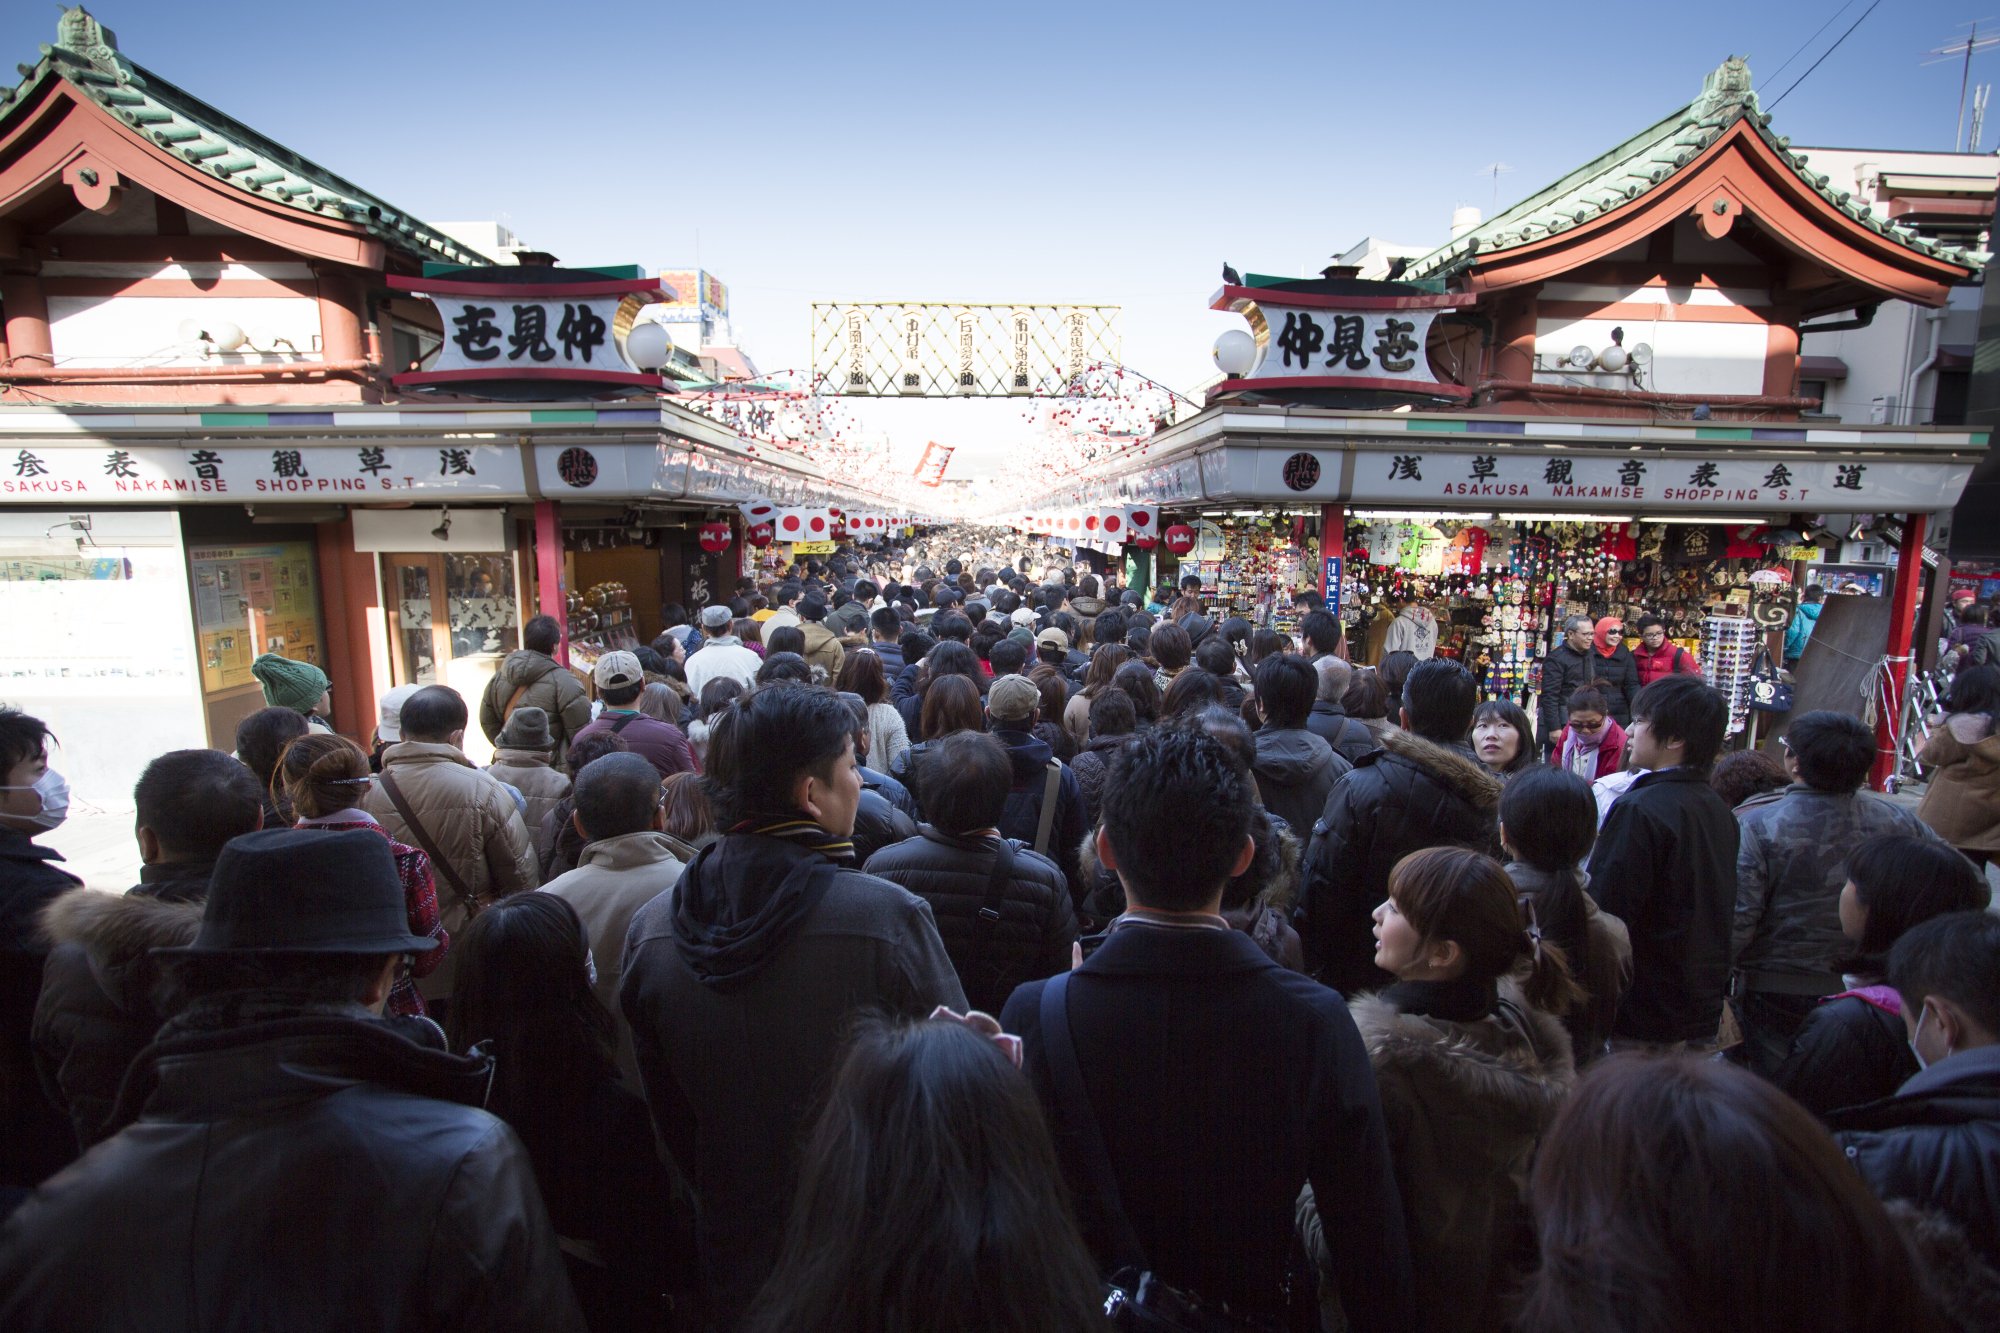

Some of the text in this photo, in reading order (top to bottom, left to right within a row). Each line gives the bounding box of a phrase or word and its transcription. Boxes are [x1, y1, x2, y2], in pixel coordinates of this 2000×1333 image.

[1277, 312, 1419, 372] 仲見世
[0, 480, 88, 492] SAKUSA
[115, 478, 227, 492] NAKAMISE
[255, 478, 365, 491] SHOPPING
[1443, 482, 1809, 501] ASAKUSA NAKAMISE SHOPPING S.T
